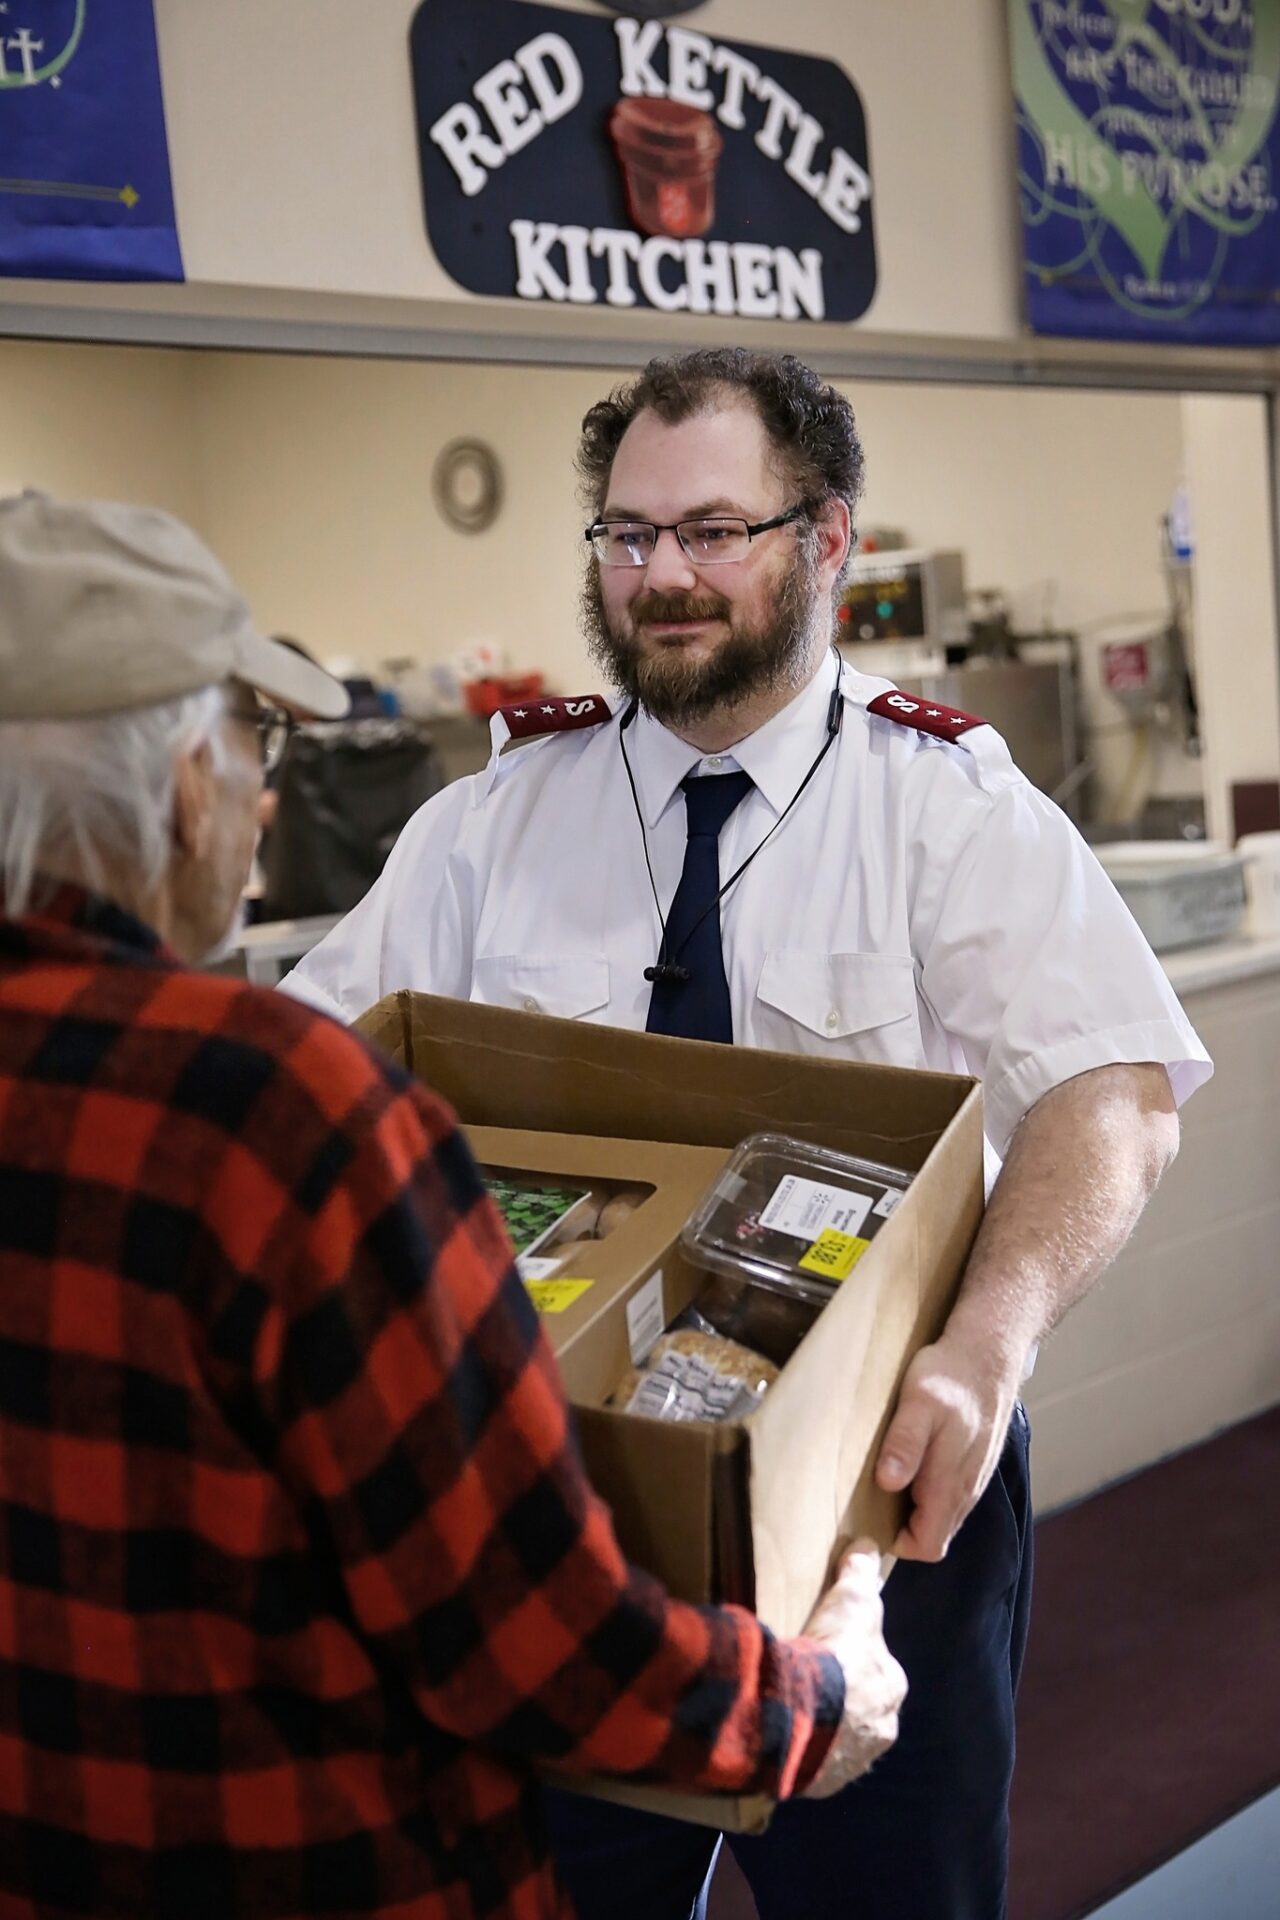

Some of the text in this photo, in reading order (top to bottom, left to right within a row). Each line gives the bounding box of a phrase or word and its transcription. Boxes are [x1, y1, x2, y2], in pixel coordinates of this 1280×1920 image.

[430, 16, 871, 234] RED KETTLE
[1045, 131, 1112, 194] HIS
[510, 218, 825, 321] KITCHEN
